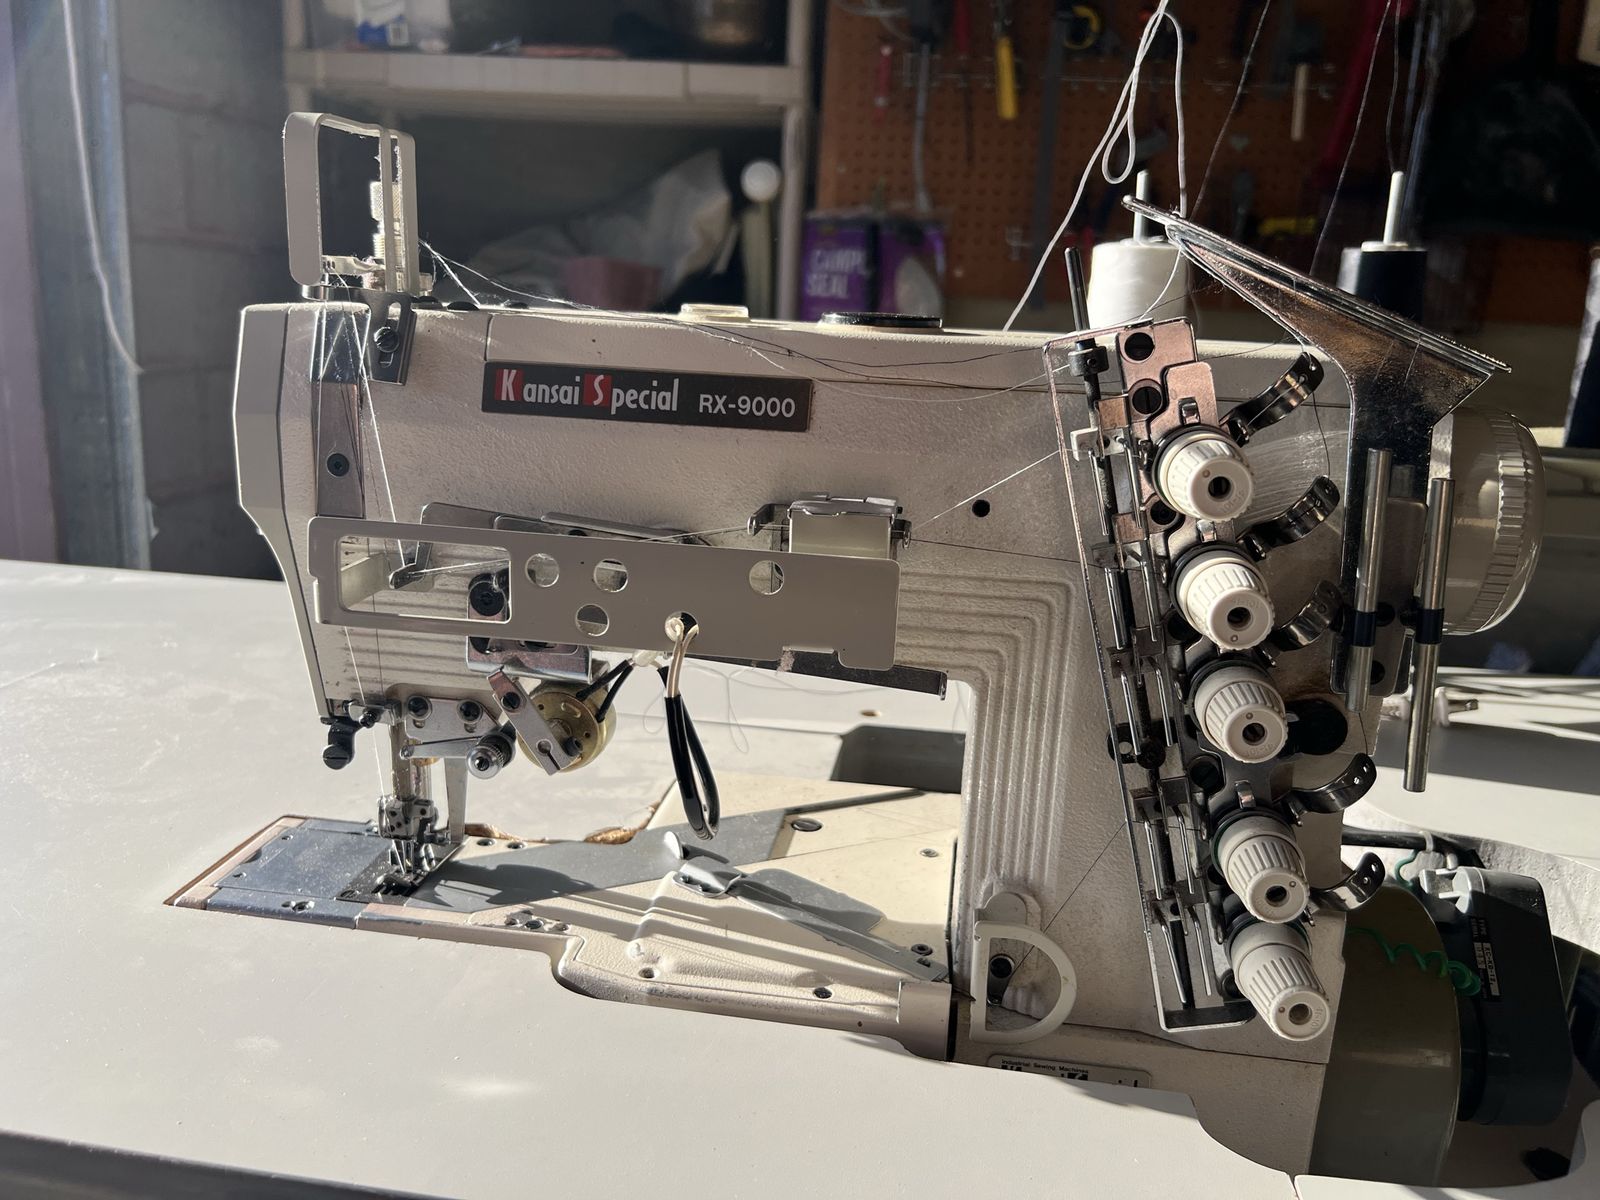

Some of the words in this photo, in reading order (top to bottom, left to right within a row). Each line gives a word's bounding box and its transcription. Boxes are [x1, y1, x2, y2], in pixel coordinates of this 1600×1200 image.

[501, 369, 580, 405] Kansai
[593, 374, 679, 414] Special
[699, 393, 796, 418] RX-9000
[1001, 1059, 1031, 1067] Industrial
[1034, 1062, 1056, 1070] Sewing
[1059, 1066, 1089, 1074] Machines
